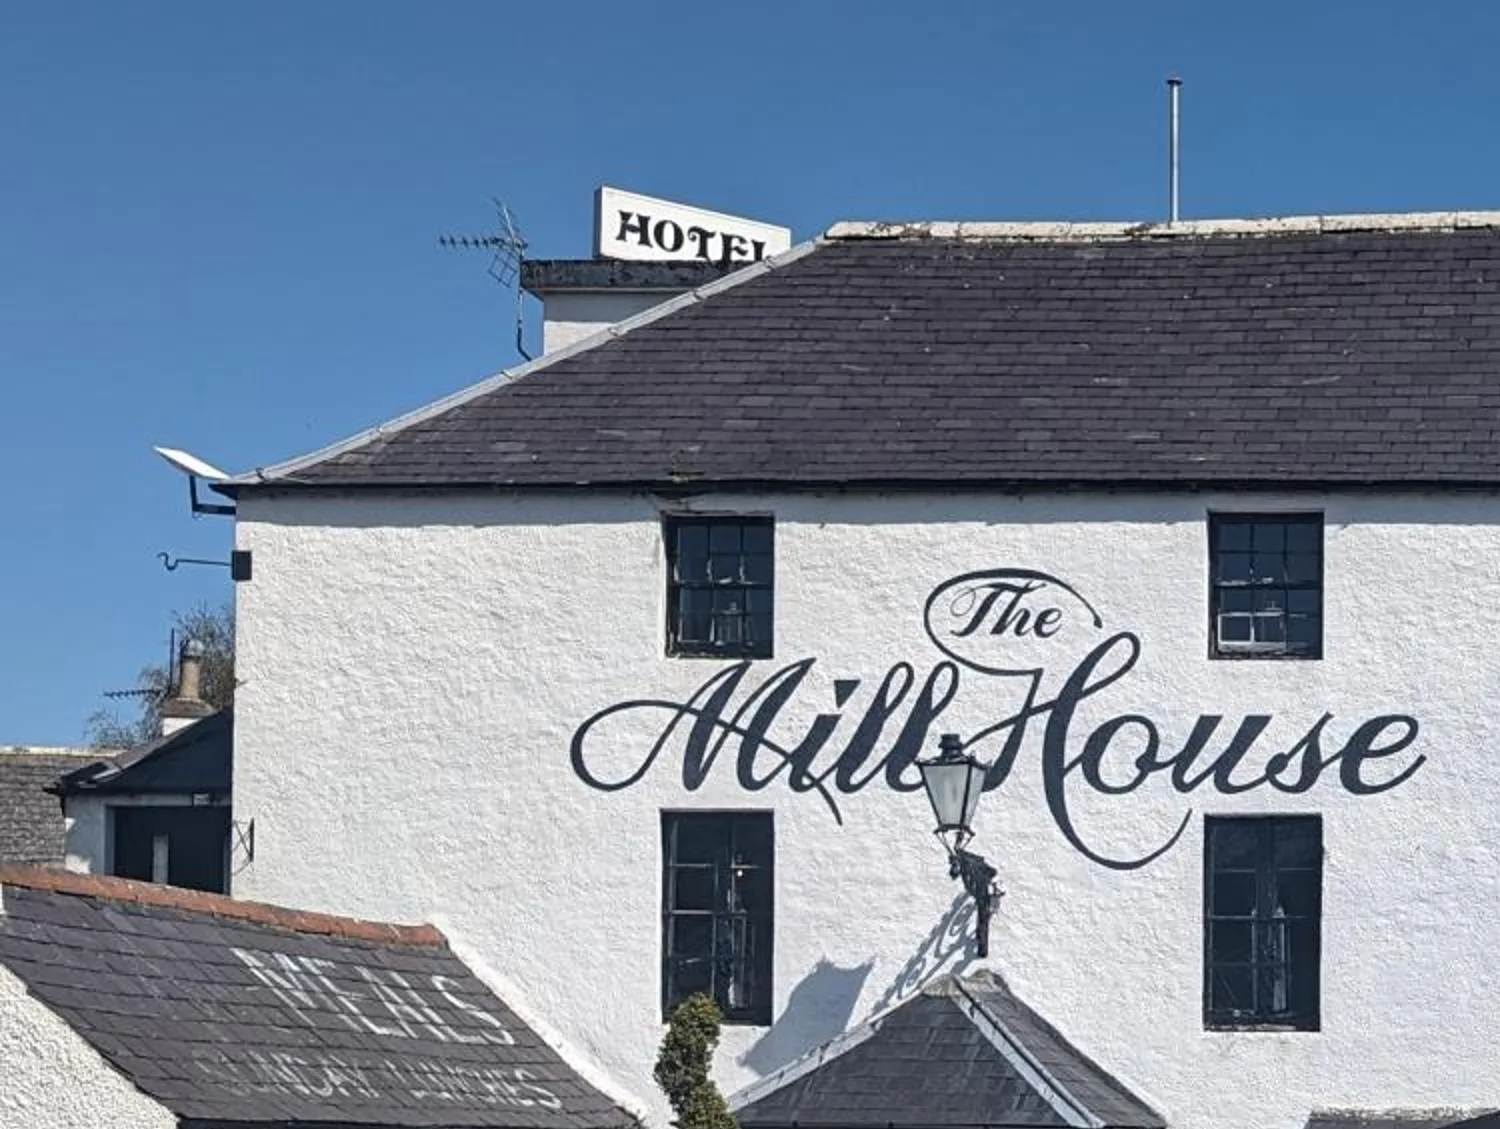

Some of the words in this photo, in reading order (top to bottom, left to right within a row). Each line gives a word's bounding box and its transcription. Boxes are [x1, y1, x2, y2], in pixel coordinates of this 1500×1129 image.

[949, 580, 1061, 638] The
[570, 656, 958, 825] Mill
[924, 568, 1427, 871] House
[229, 948, 514, 1045] MEALS
